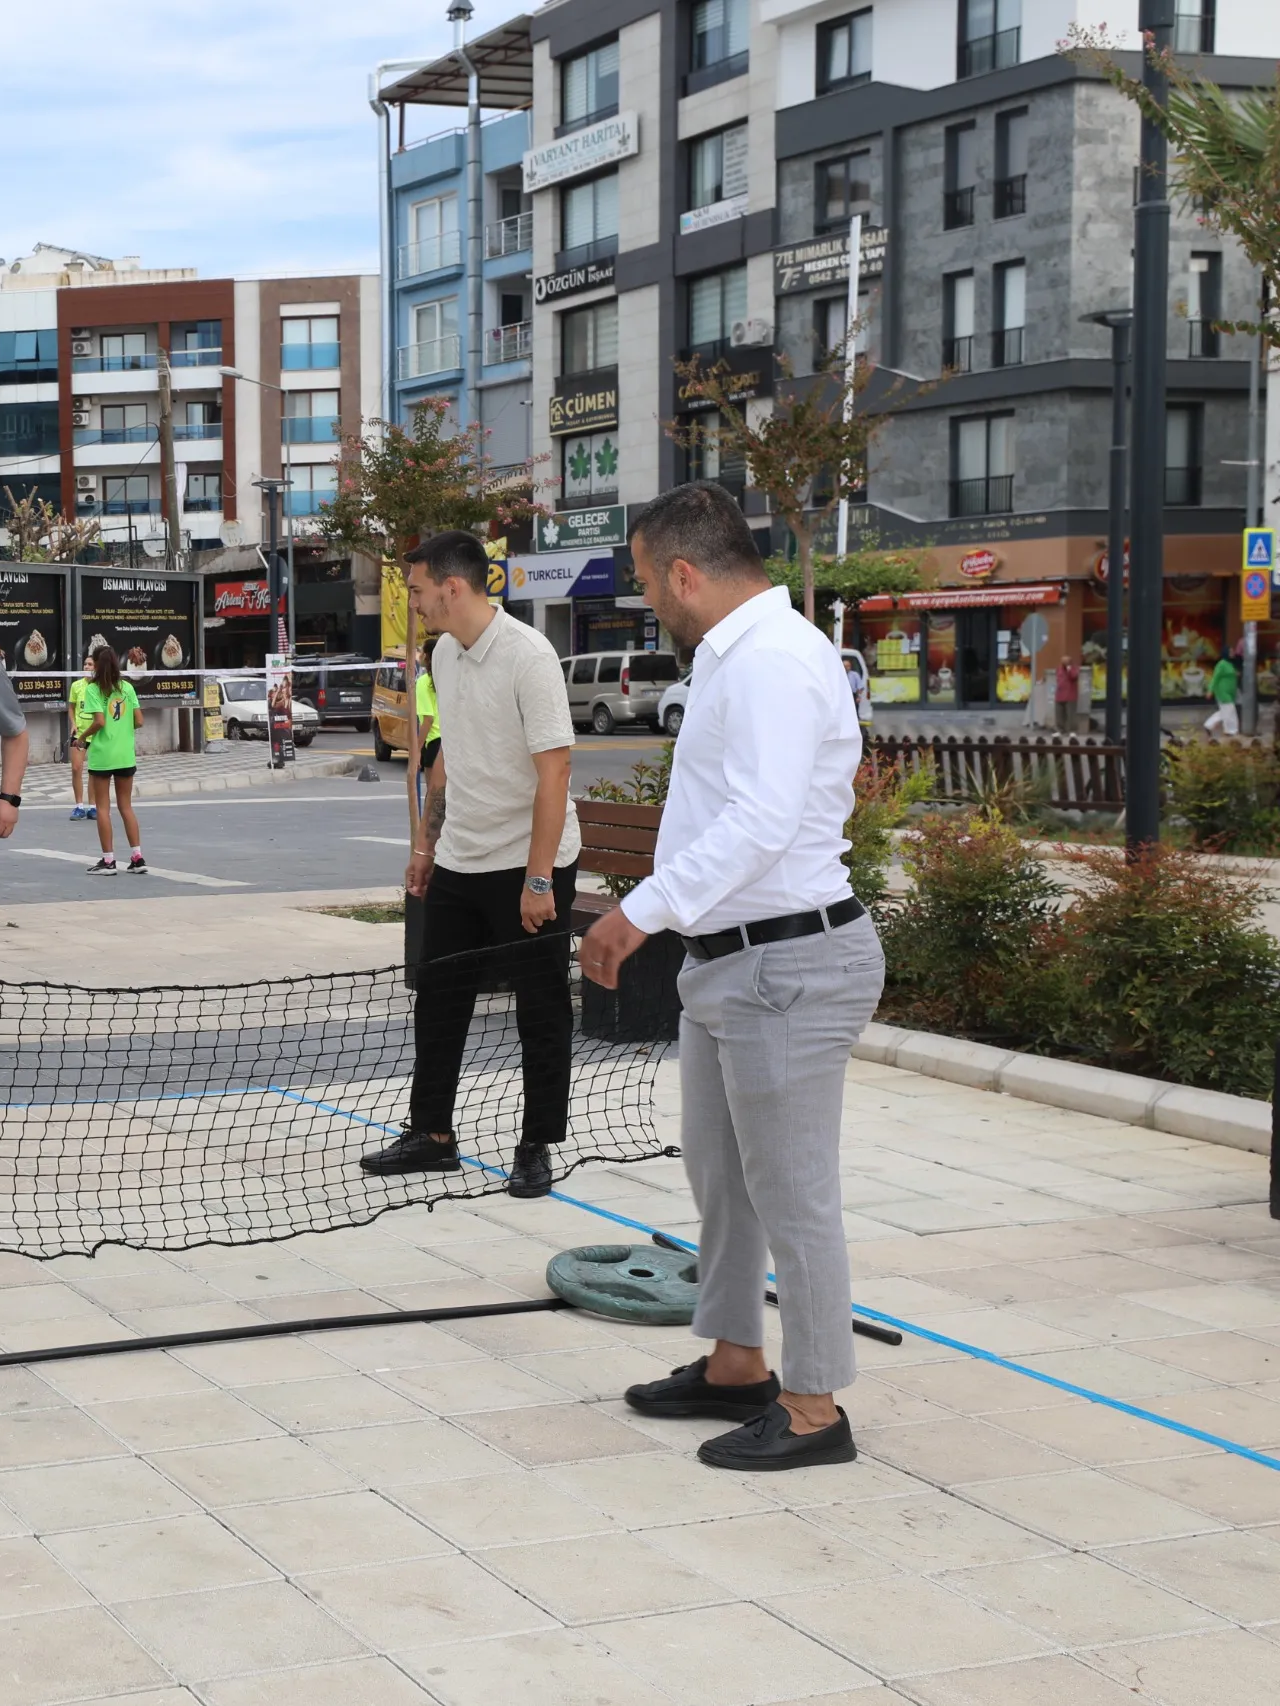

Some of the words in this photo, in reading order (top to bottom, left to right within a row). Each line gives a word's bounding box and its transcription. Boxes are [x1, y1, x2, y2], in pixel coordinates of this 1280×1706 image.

[534, 138, 579, 166] VARYANT
[582, 123, 622, 149] HARİTA
[804, 256, 839, 273] MESKEN
[865, 246, 886, 260] YAPI
[547, 268, 585, 294] ÖZGÜN
[565, 389, 616, 418] ÇÜMEN
[568, 511, 610, 528] GELECEK
[103, 578, 134, 591] OSMANLI
[527, 567, 573, 582] TURKCELL
